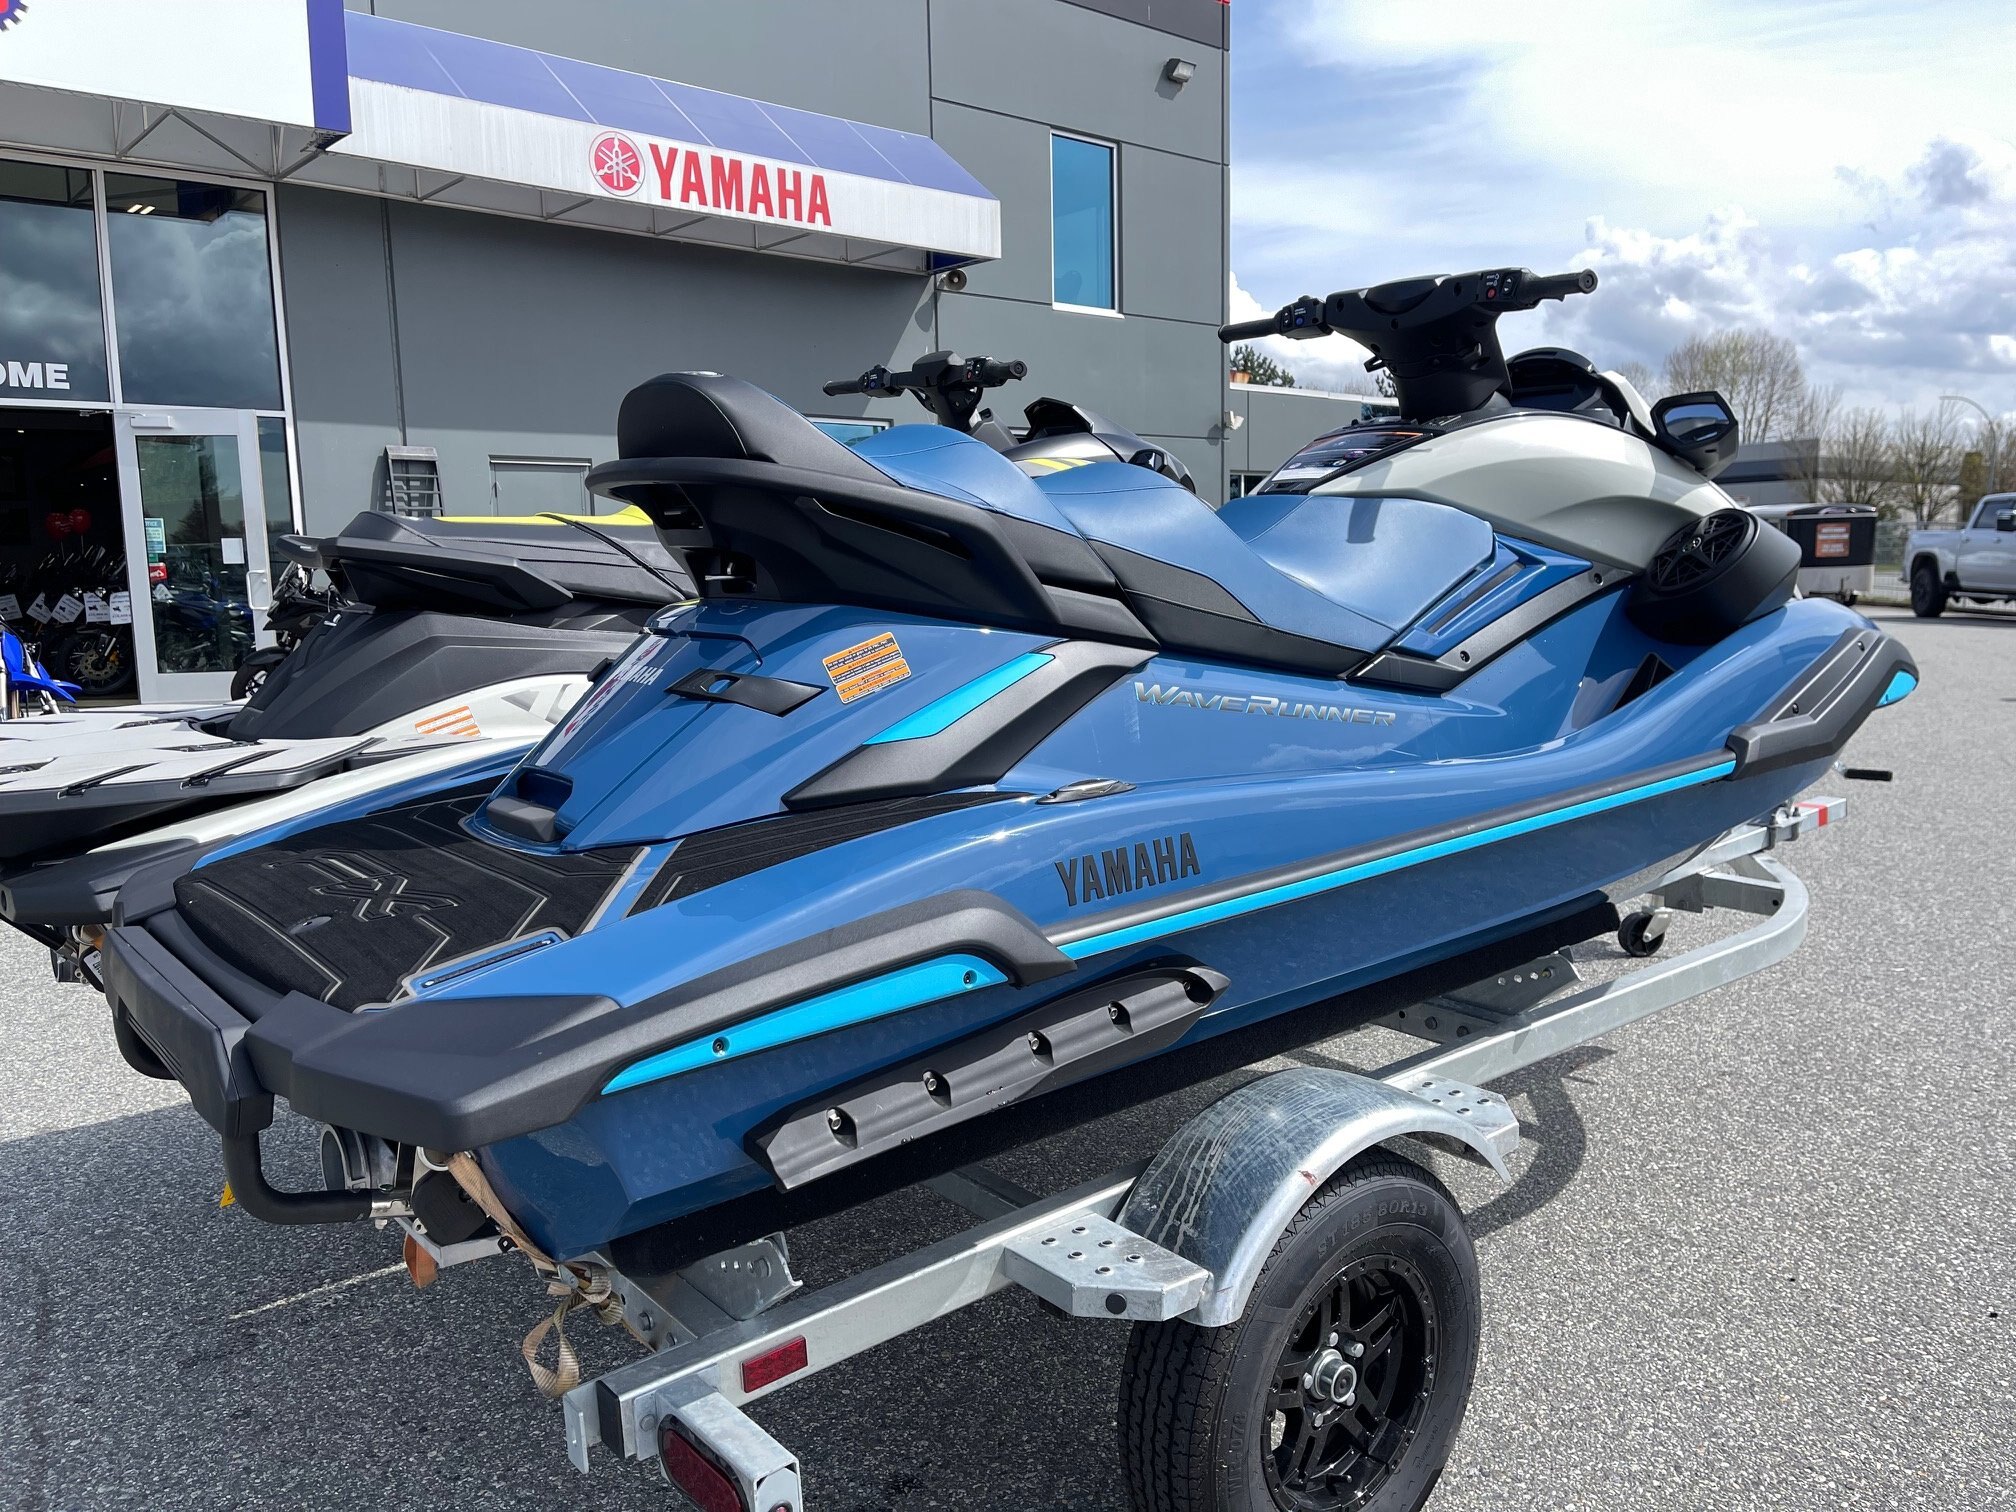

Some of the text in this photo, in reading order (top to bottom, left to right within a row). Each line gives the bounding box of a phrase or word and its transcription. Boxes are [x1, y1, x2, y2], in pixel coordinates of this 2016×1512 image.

[648, 143, 832, 226] YAMAHA
[0, 361, 70, 389] ME
[1054, 832, 1200, 907] YAMAHA
